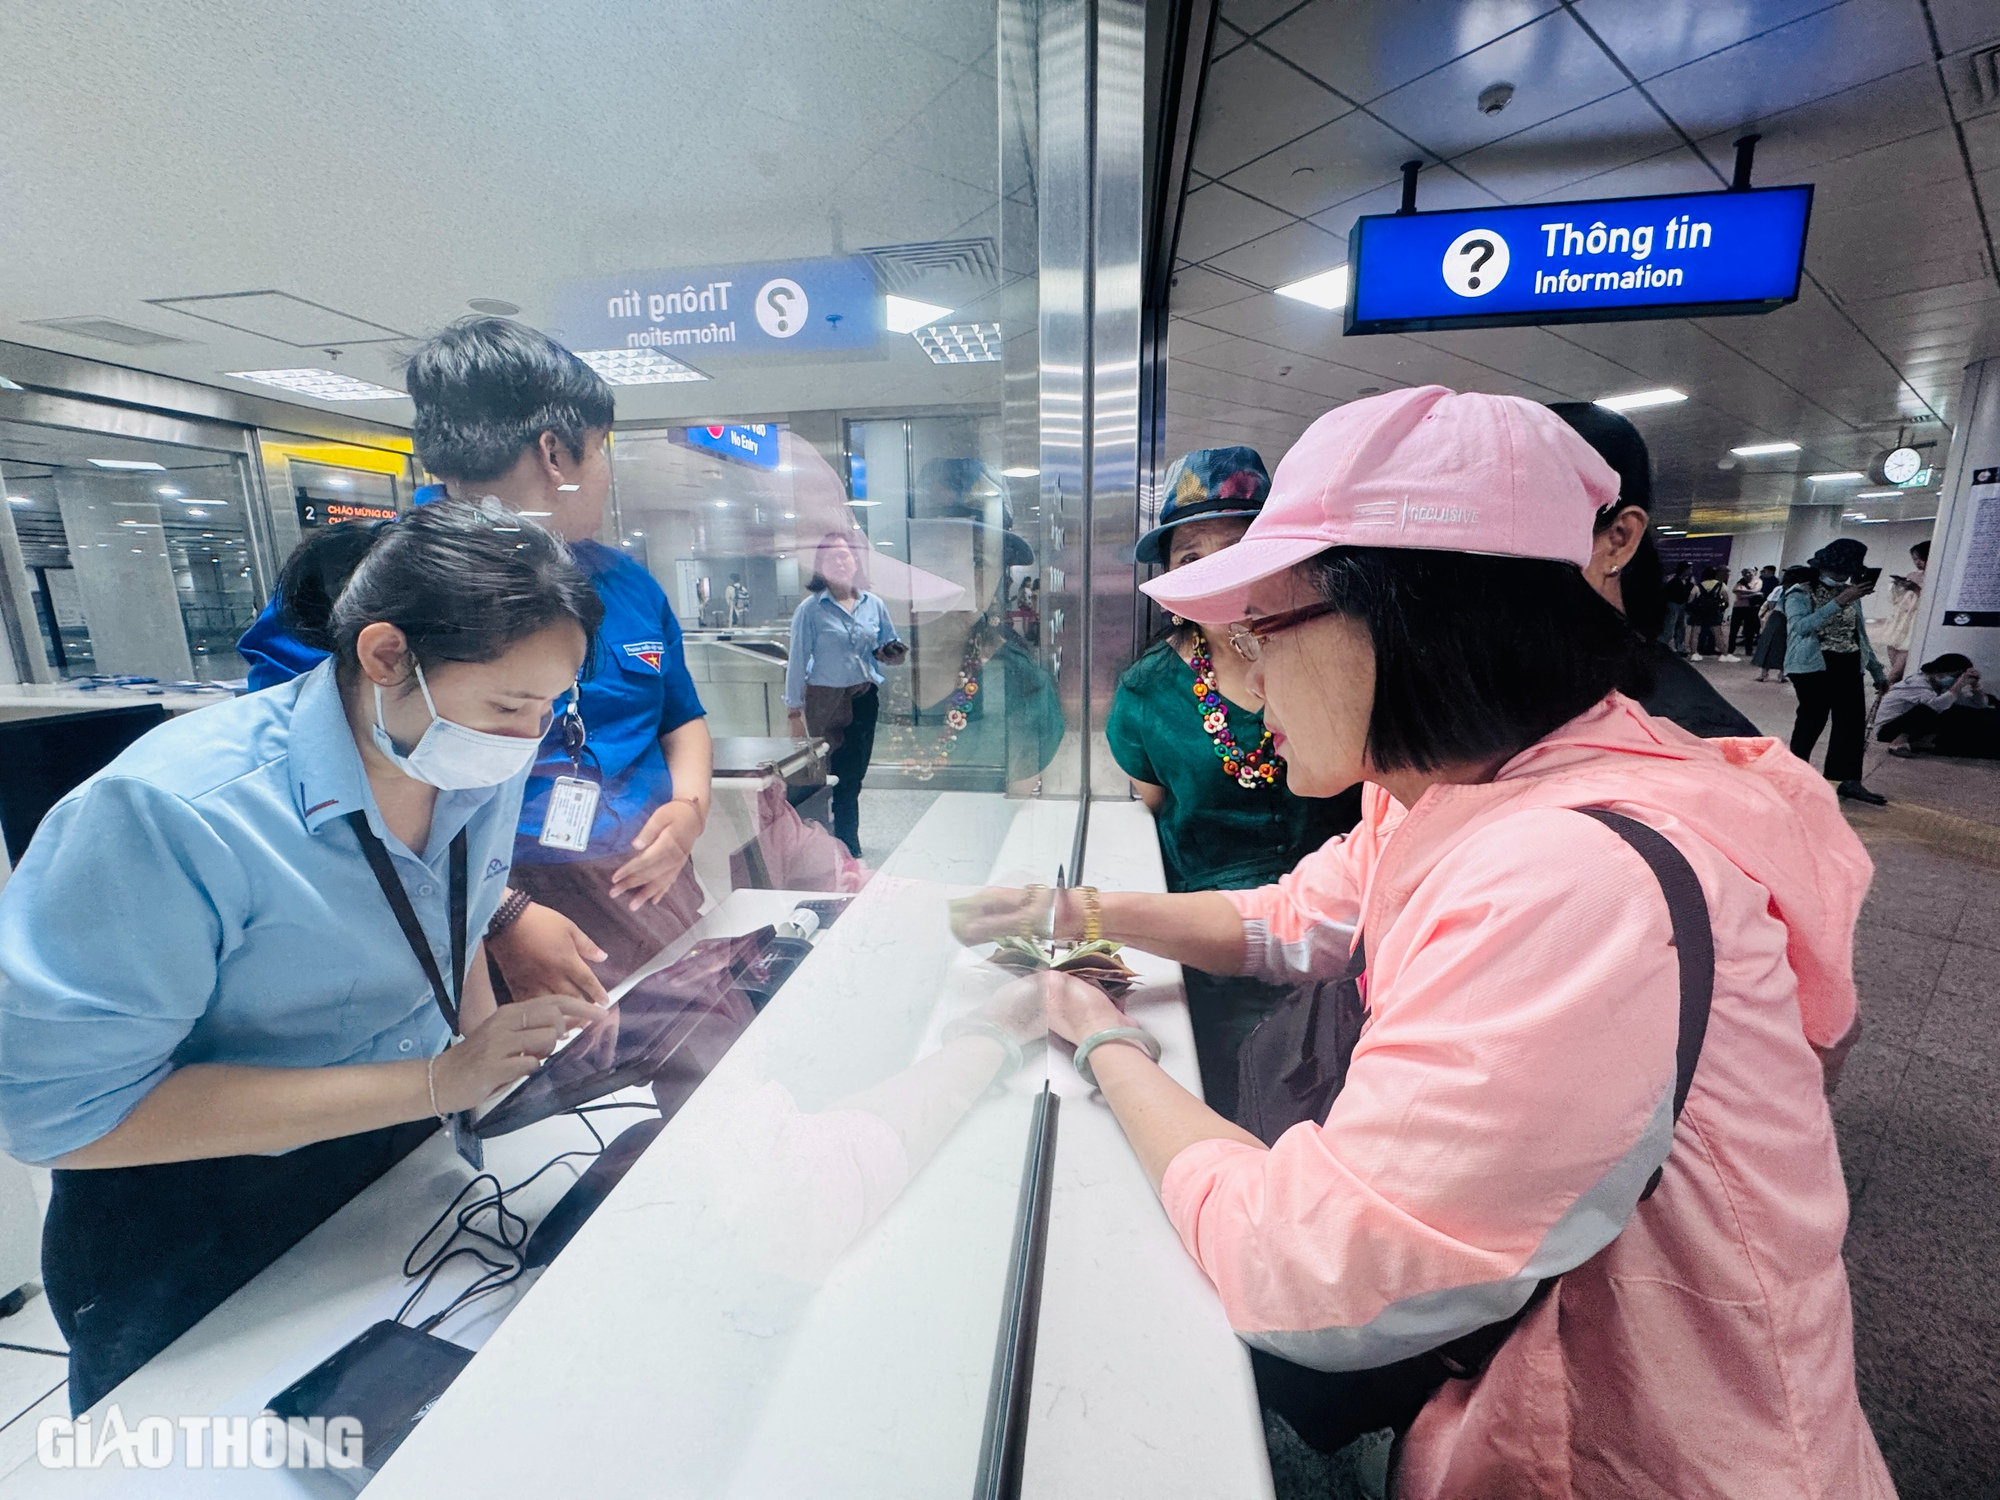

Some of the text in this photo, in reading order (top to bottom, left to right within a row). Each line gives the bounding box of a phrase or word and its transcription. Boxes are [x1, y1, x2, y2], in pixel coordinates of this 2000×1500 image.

[1541, 215, 1712, 261] Thông tin
[1534, 264, 1683, 294] Information
[731, 430, 758, 456] No Entry
[305, 506, 315, 520] 2
